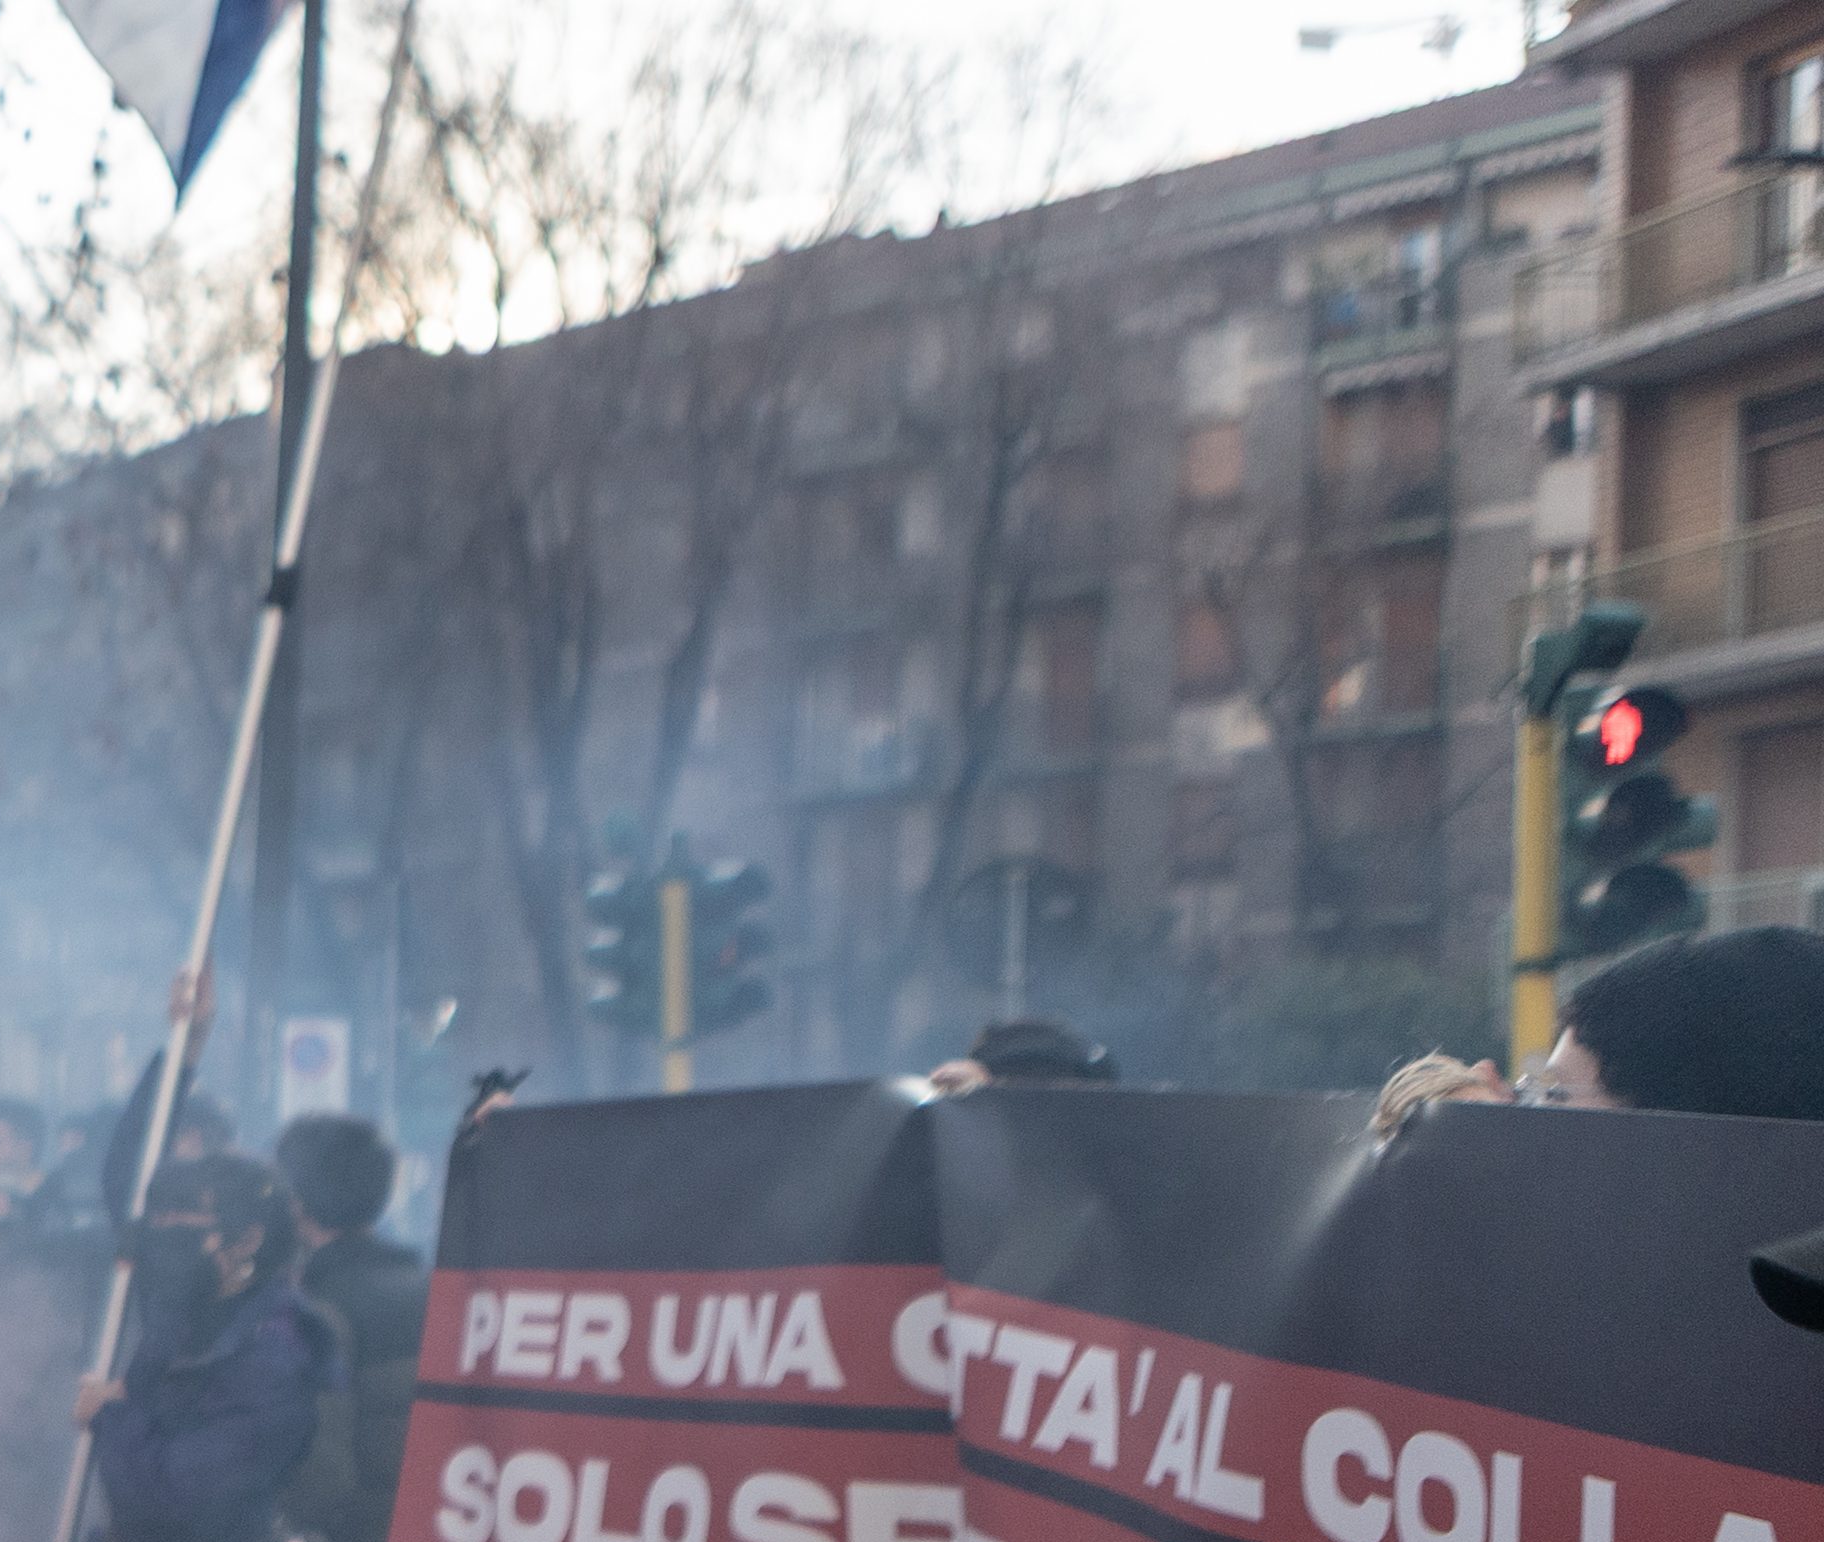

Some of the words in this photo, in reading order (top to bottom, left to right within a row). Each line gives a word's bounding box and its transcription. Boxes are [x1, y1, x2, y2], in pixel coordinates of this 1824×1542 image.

[459, 1292, 632, 1382] PER
[650, 1292, 845, 1391] UNA
[1144, 1372, 1265, 1522] AL
